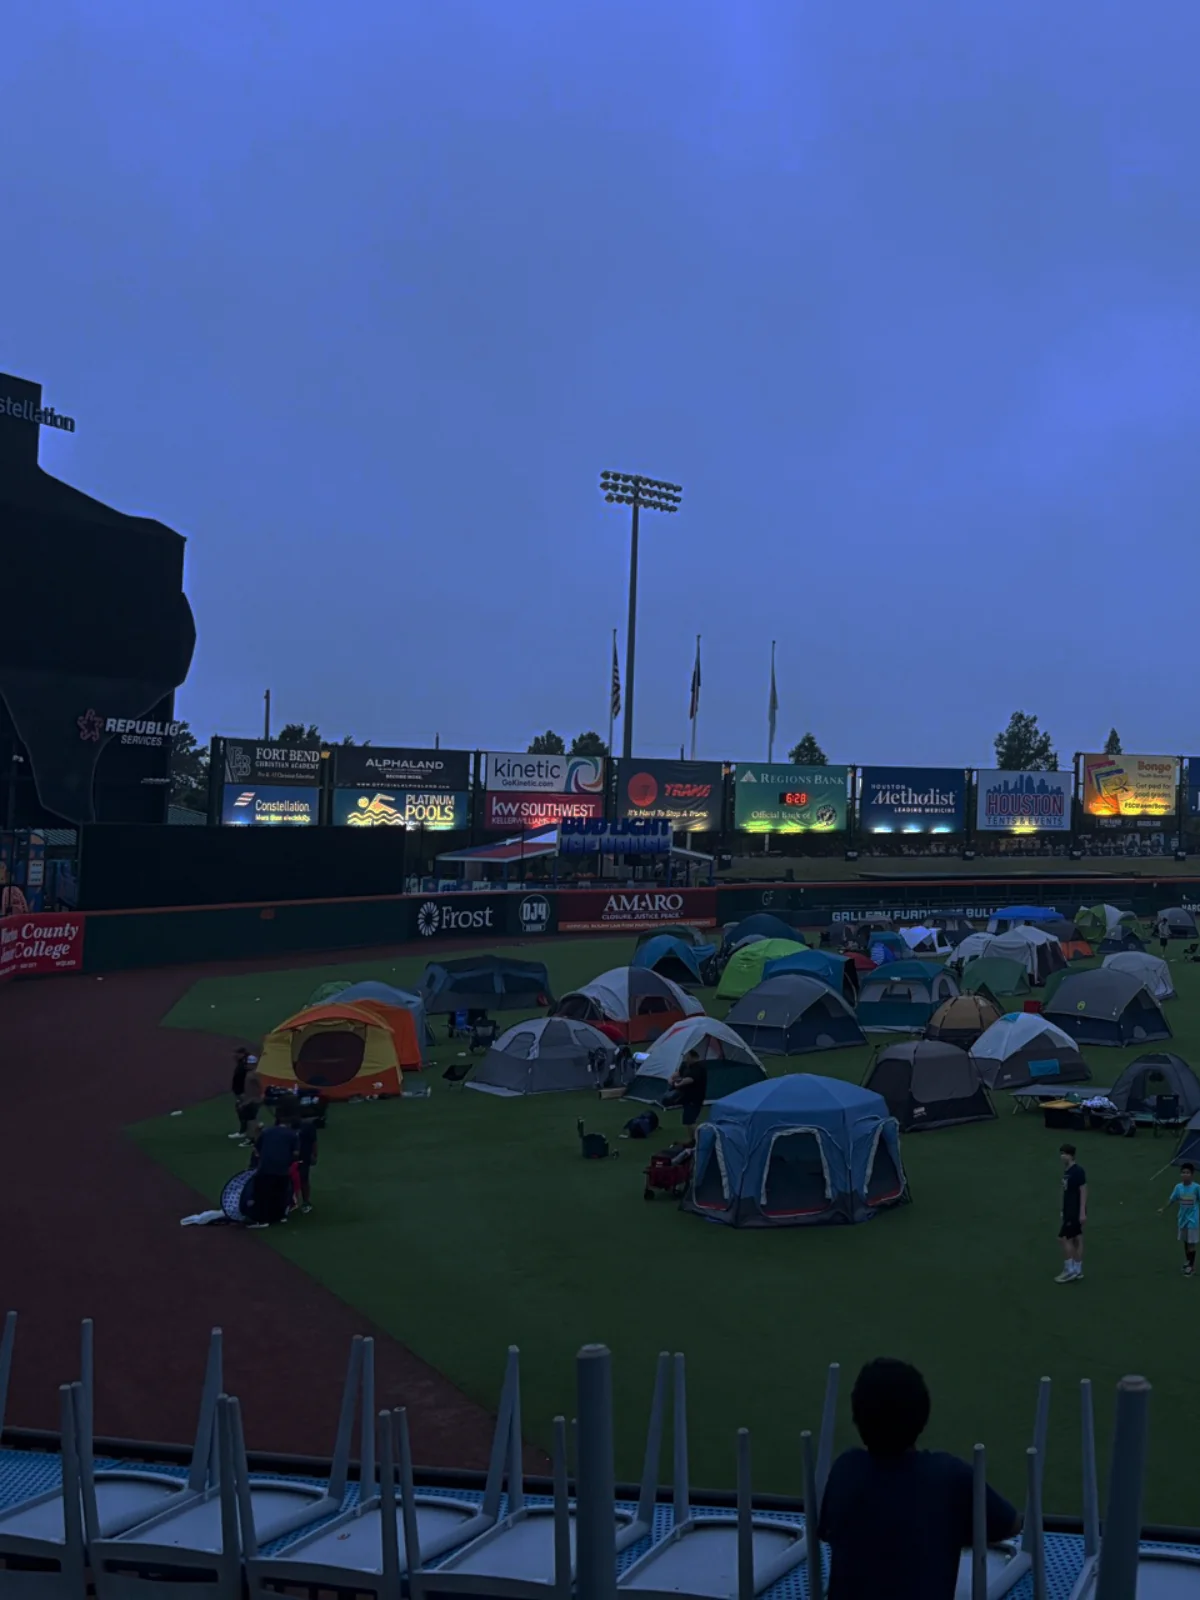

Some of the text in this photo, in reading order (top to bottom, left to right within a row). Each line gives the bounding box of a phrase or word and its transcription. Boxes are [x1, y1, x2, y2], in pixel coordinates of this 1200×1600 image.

[105, 718, 180, 736] REPUBLIC
[120, 734, 163, 746] SERVICES
[255, 747, 320, 763] FORT BEND
[255, 761, 289, 769] CHRISTIAN
[365, 758, 444, 770] ALPHALAND
[494, 758, 561, 779] kinetic
[1138, 760, 1172, 773] Bongo
[502, 779, 553, 787] GoKinetic.com
[760, 773, 844, 785] REGIONS BANK
[405, 794, 455, 805] PLATINUM
[785, 793, 806, 804] 6:28
[871, 787, 956, 806] Methodist
[985, 793, 1064, 816] HOUSTON
[404, 805, 455, 820] POOLS
[491, 796, 596, 817] kw SOUTHWEST
[751, 810, 780, 819] Official
[561, 817, 607, 835] BUD
[609, 817, 672, 836] LIGHT
[987, 815, 1017, 825] TENTS
[1029, 816, 1064, 826] EVENTS
[603, 893, 684, 911] AMARO
[441, 905, 494, 929] Frost
[523, 902, 547, 921] DJ4
[21, 923, 79, 940] County
[15, 941, 71, 959] College
